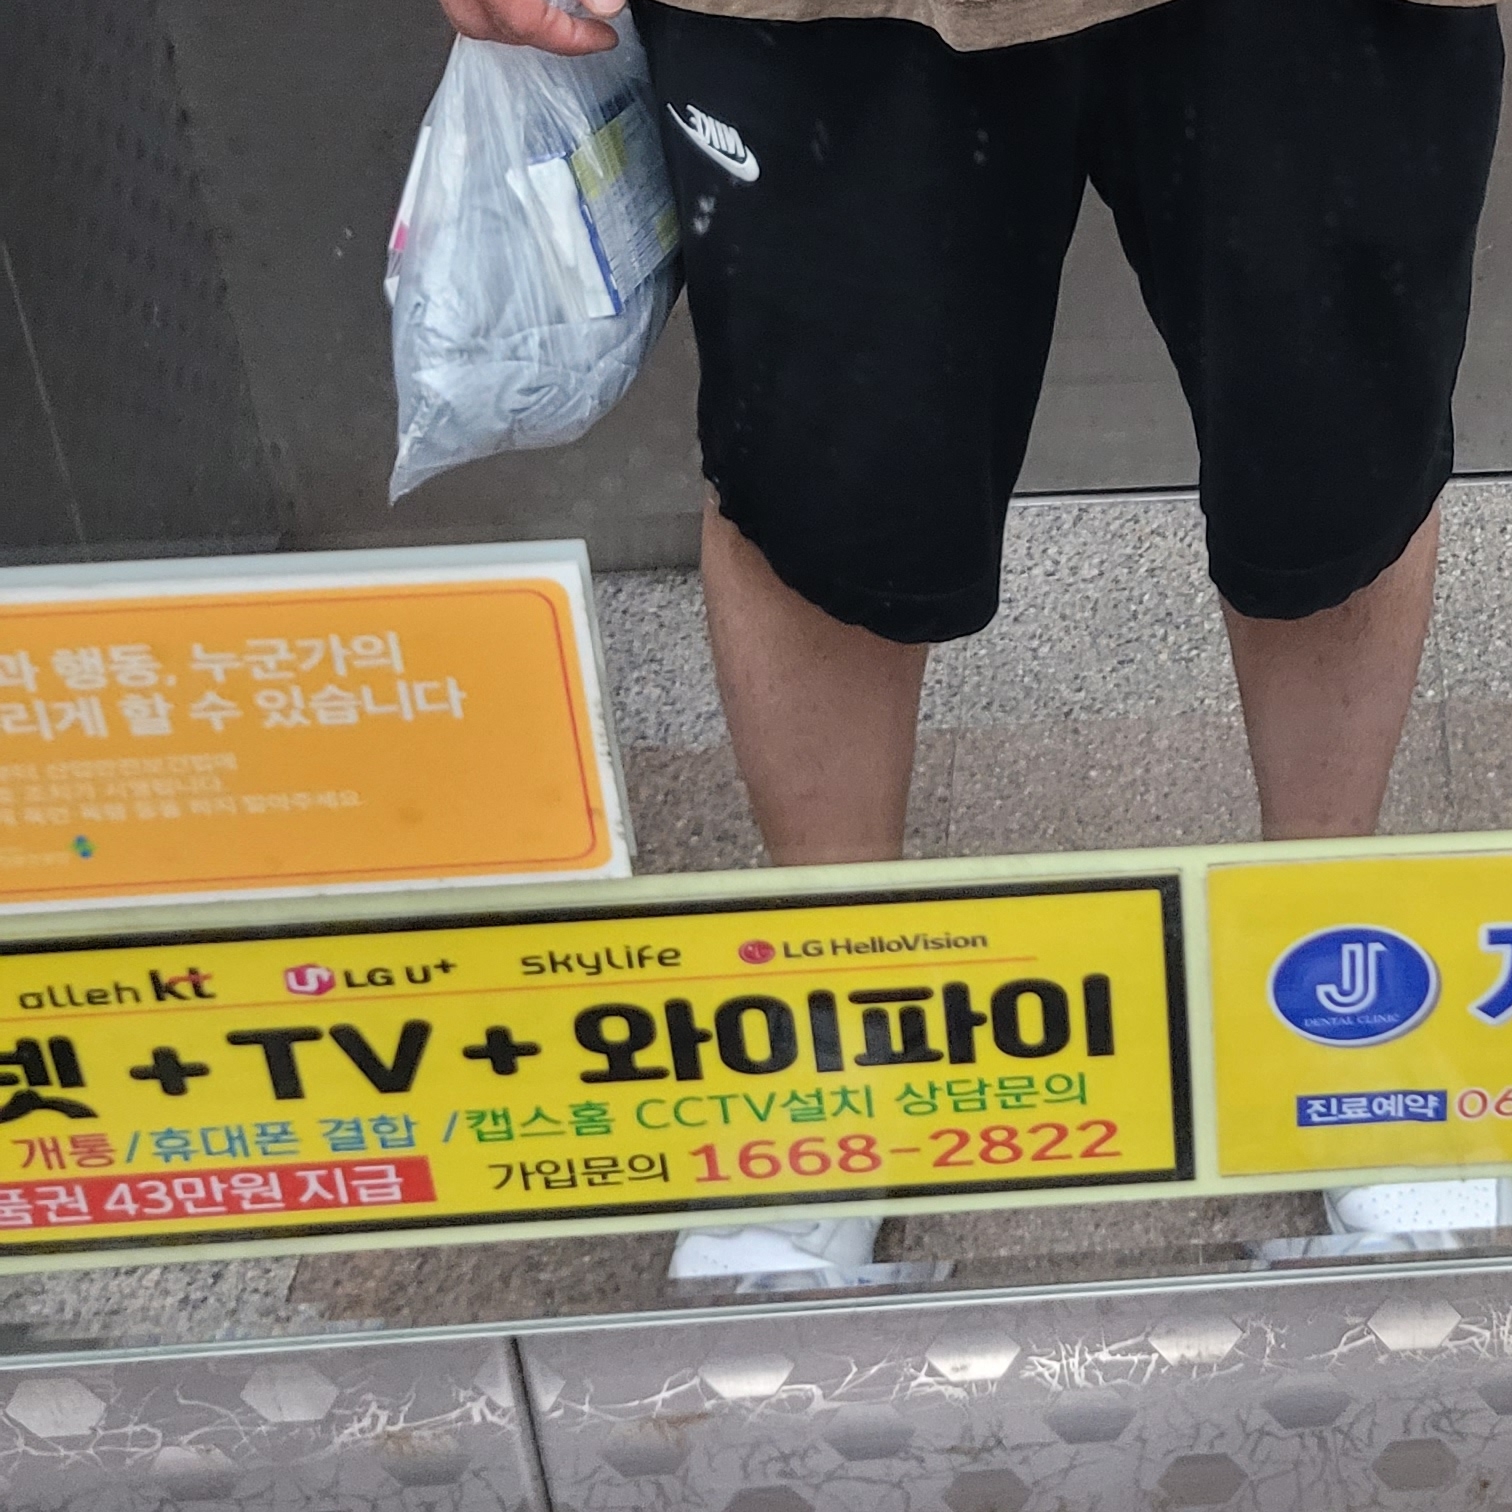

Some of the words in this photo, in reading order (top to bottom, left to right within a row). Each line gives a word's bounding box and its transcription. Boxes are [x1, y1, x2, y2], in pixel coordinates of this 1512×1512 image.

[190, 631, 406, 685] 누군가의
[122, 693, 172, 738] 할
[189, 690, 243, 733] 수
[255, 676, 467, 730] 있습니다
[782, 939, 825, 960] LG
[831, 931, 989, 956] HelloVision
[148, 968, 217, 1002] kt
[344, 968, 395, 988] LG
[226, 1018, 433, 1101] TV
[573, 972, 1116, 1085] 와이파이
[319, 1113, 418, 1156] 결합
[636, 1083, 875, 1131] CCTV설치
[895, 1071, 1090, 1119] 상담문의
[1303, 1095, 1442, 1121] 진료예약
[487, 1151, 671, 1193] 가입문의
[689, 1118, 1123, 1184] 1668-2822
[104, 1172, 287, 1217] 43만원
[295, 1162, 405, 1207] 지급
